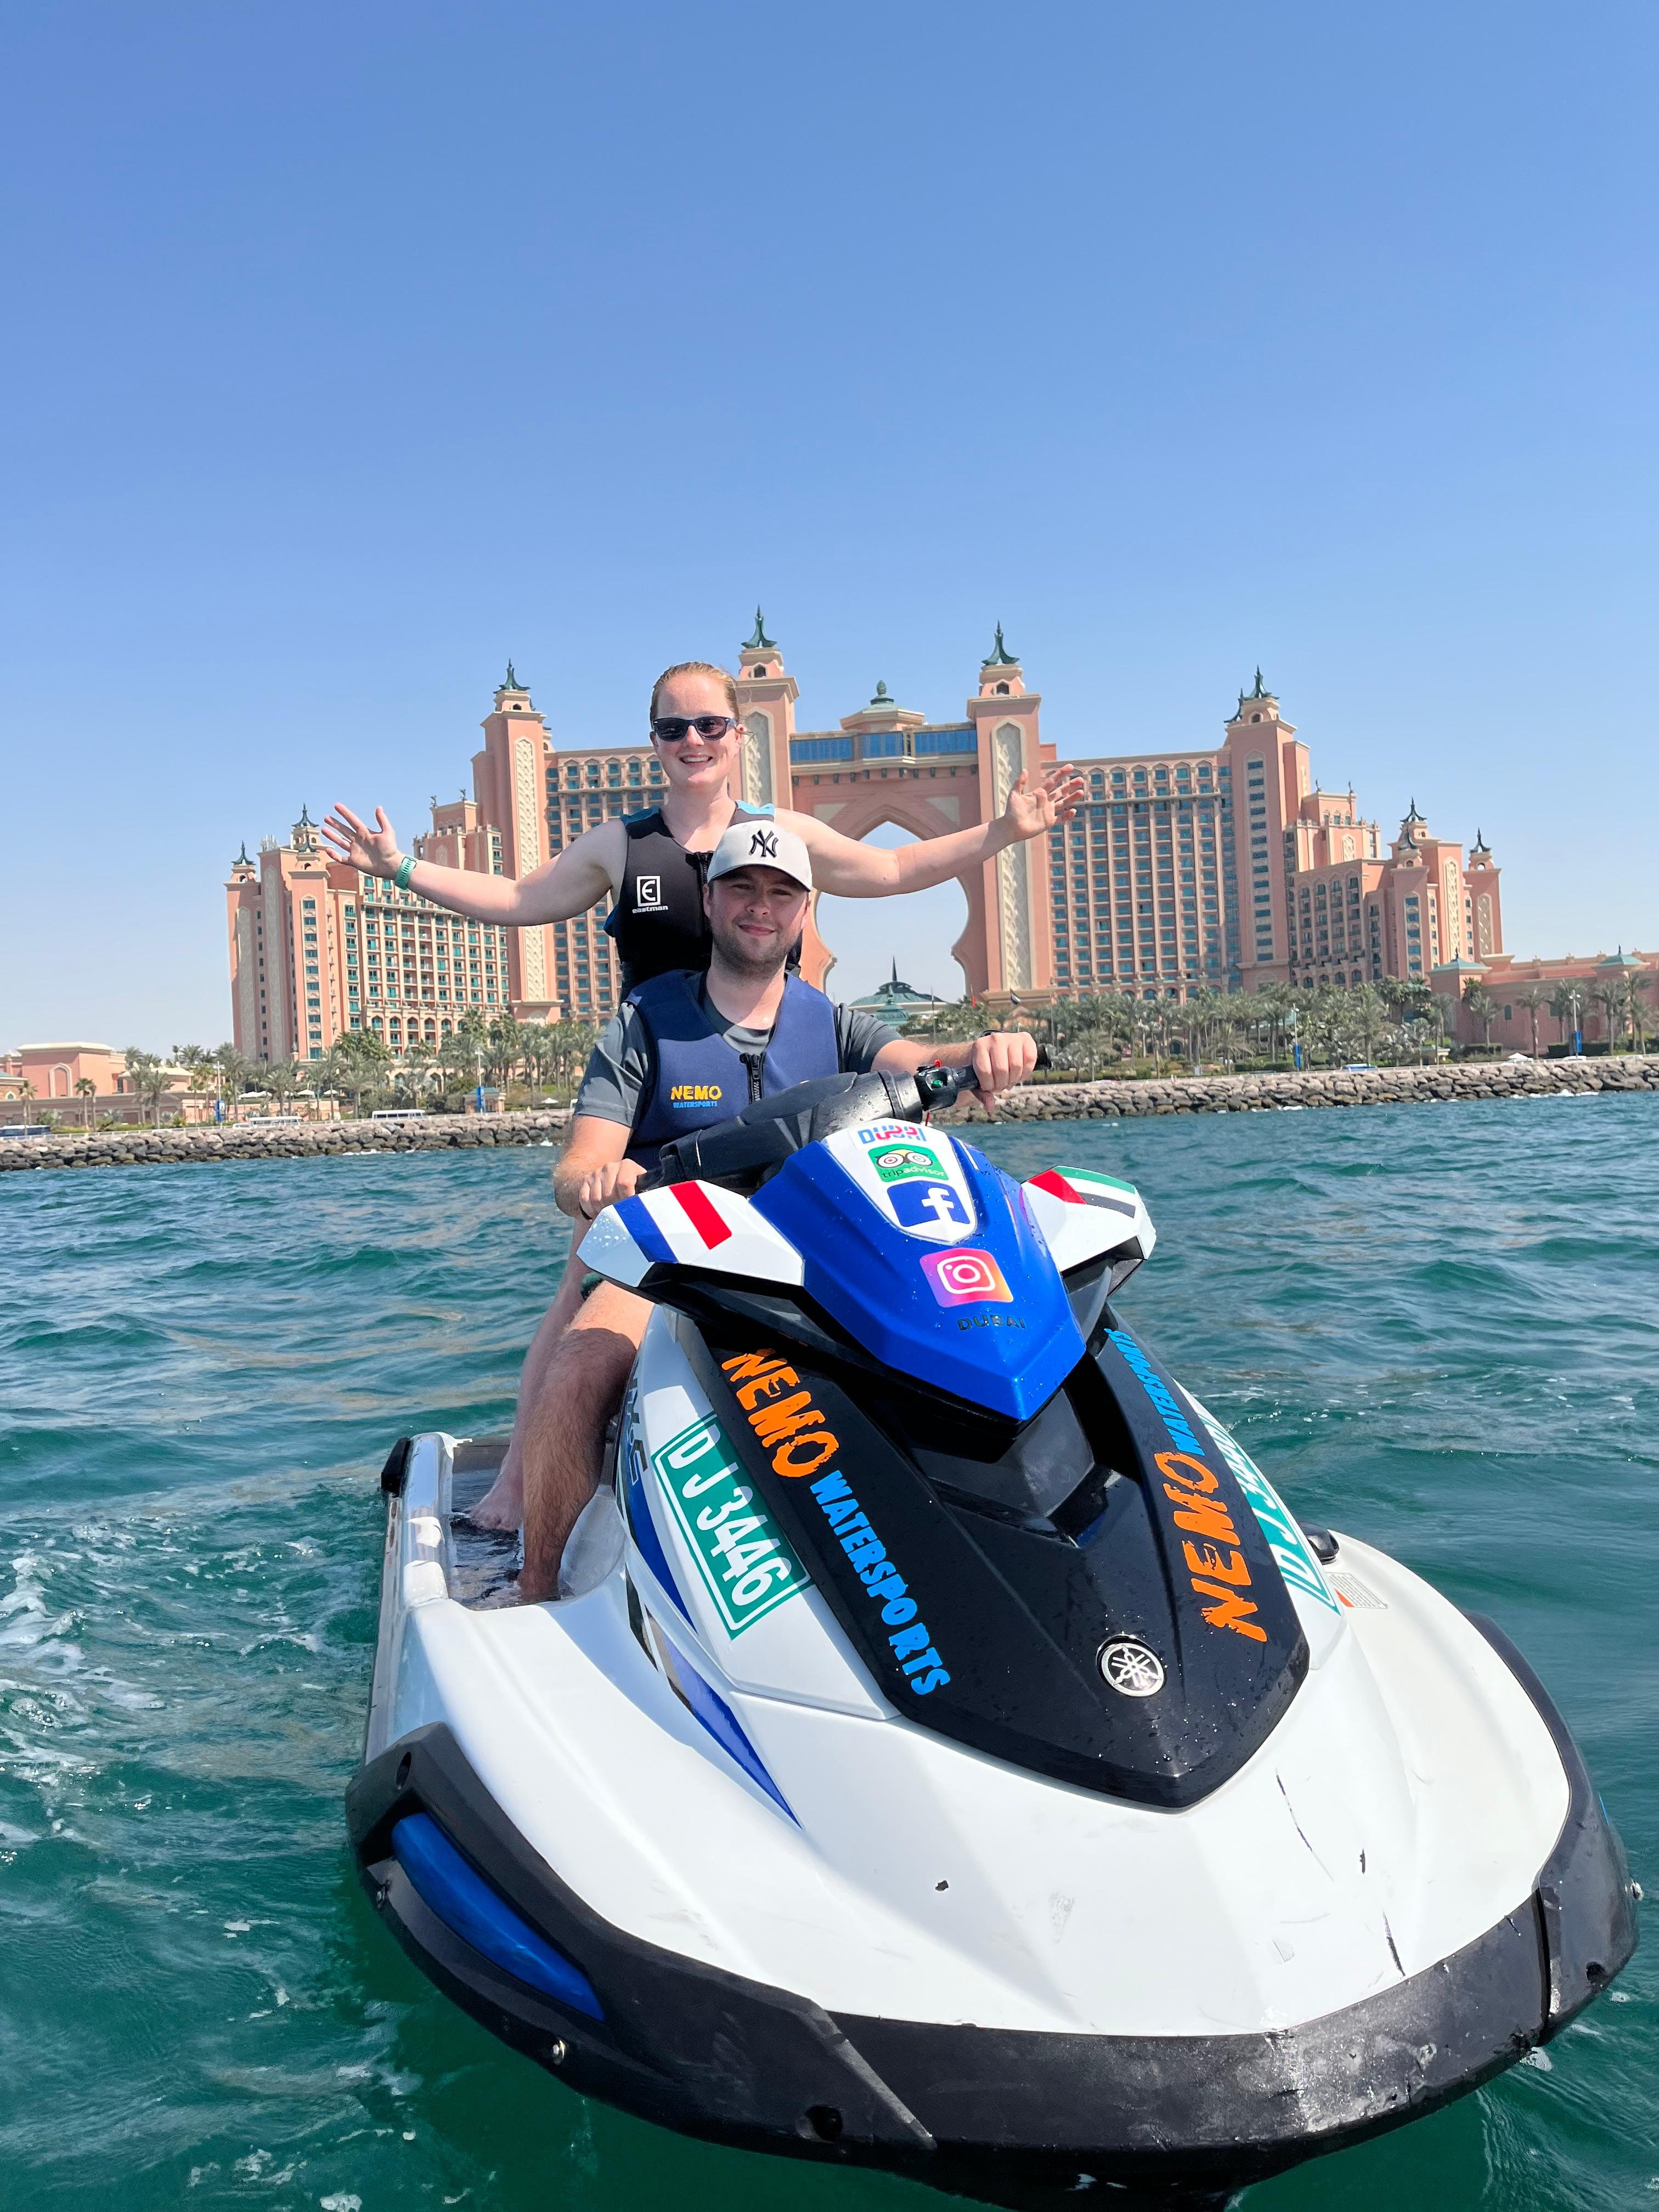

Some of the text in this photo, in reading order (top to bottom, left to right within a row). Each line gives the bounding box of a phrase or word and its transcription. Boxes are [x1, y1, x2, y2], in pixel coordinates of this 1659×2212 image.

[748, 829, 779, 859] NY
[632, 905, 669, 913] eastman
[670, 1085, 722, 1100] NEMO
[673, 1101, 718, 1109] WATERSPORTS
[882, 1164, 945, 1178] tripadvisor
[957, 1314, 1026, 1331] DUBAI
[721, 1348, 951, 1696] NEMO WATERSPORTS
[696, 1485, 793, 1606] 3446
[1154, 1452, 1268, 1642] NEMO
